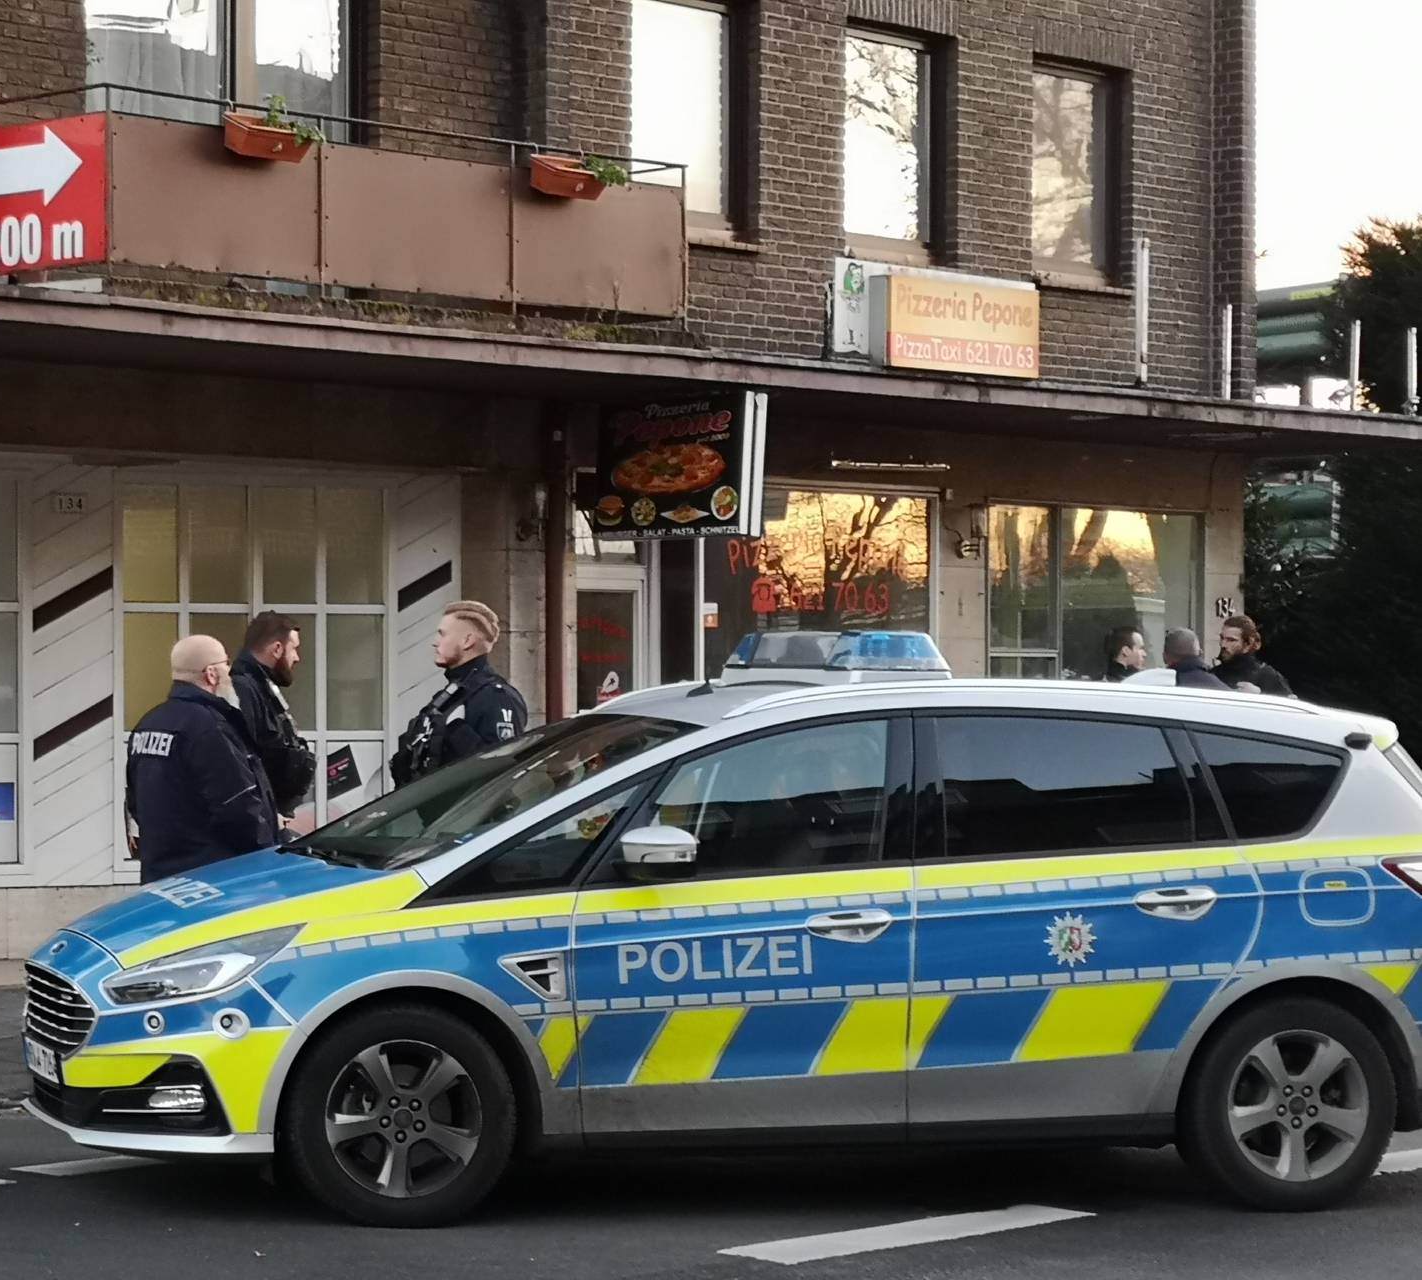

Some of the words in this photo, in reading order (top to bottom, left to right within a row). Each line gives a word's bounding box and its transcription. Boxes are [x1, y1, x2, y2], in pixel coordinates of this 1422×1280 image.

[52, 220, 84, 260] m
[896, 284, 967, 321] Pizzeria
[972, 292, 1033, 332] Pepone
[966, 343, 990, 365] 621
[994, 344, 1013, 366] 70
[1016, 346, 1034, 368] 63
[59, 498, 82, 510] 134
[832, 582, 858, 612] 70
[864, 583, 890, 614] 63
[618, 935, 813, 984] POLIZEI
